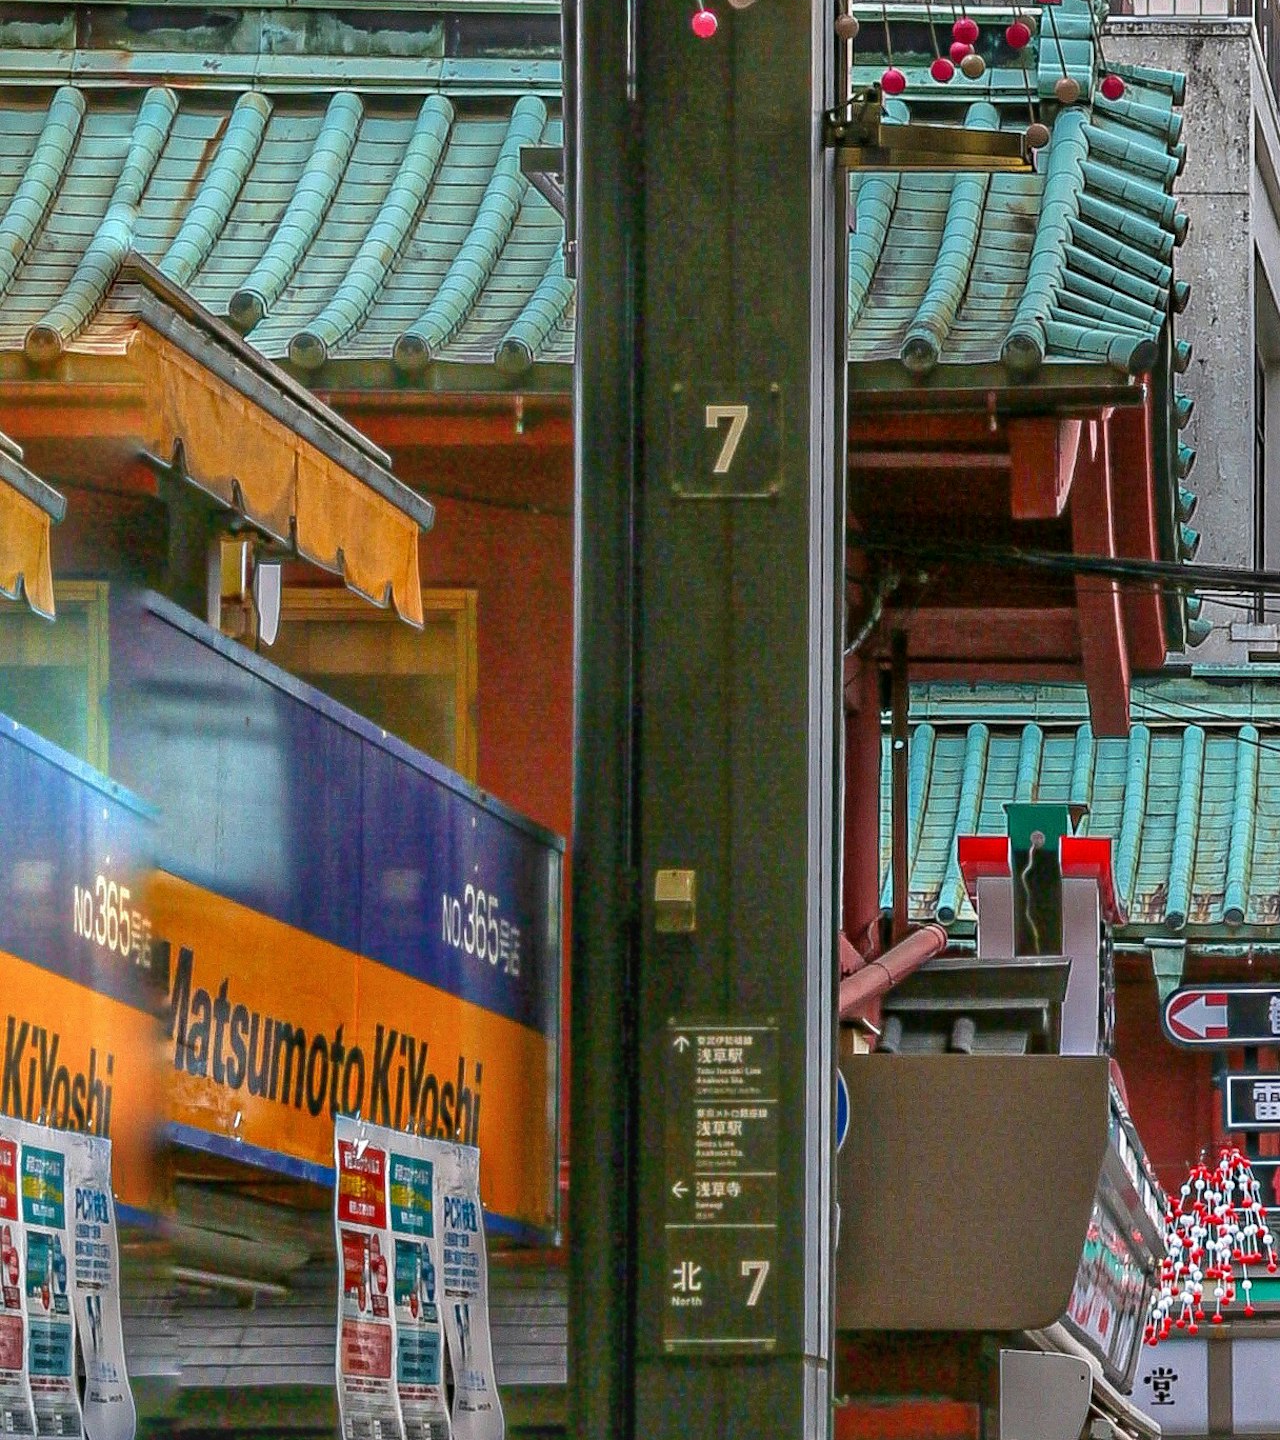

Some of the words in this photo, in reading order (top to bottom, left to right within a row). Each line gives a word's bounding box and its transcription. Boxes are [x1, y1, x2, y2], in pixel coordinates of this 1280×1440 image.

[704, 404, 749, 474] 7
[163, 938, 366, 1118] Matsumoto
[672, 1260, 703, 1292] 北
[741, 1260, 771, 1307] 7
[671, 1296, 703, 1307] North
